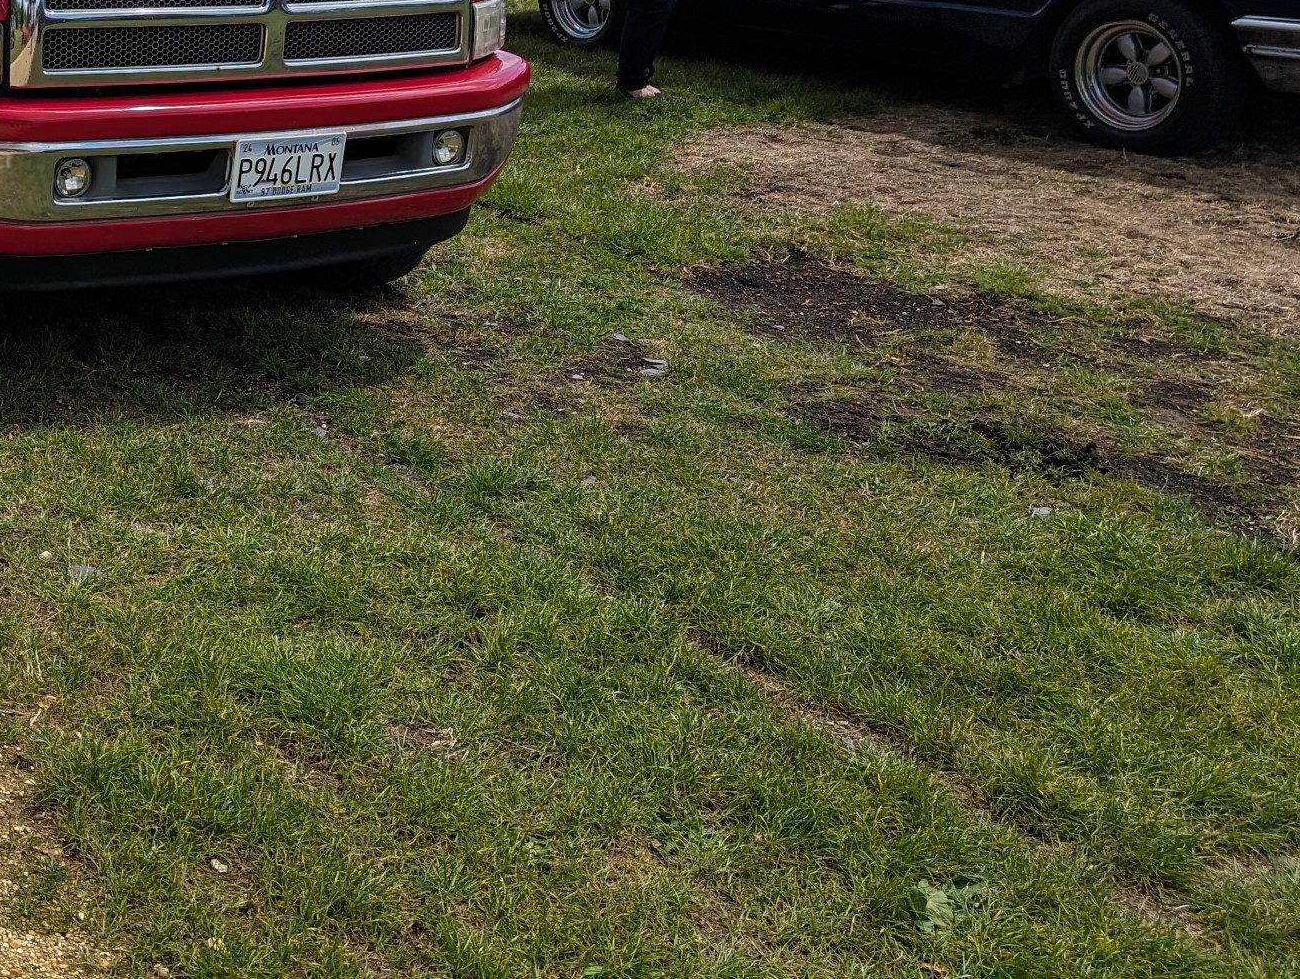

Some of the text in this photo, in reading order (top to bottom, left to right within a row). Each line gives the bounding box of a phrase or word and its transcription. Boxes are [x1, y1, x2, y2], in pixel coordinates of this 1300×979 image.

[1147, 13, 1195, 88] GENERAL
[263, 142, 319, 156] MONTANA
[237, 152, 338, 189] P946LRX
